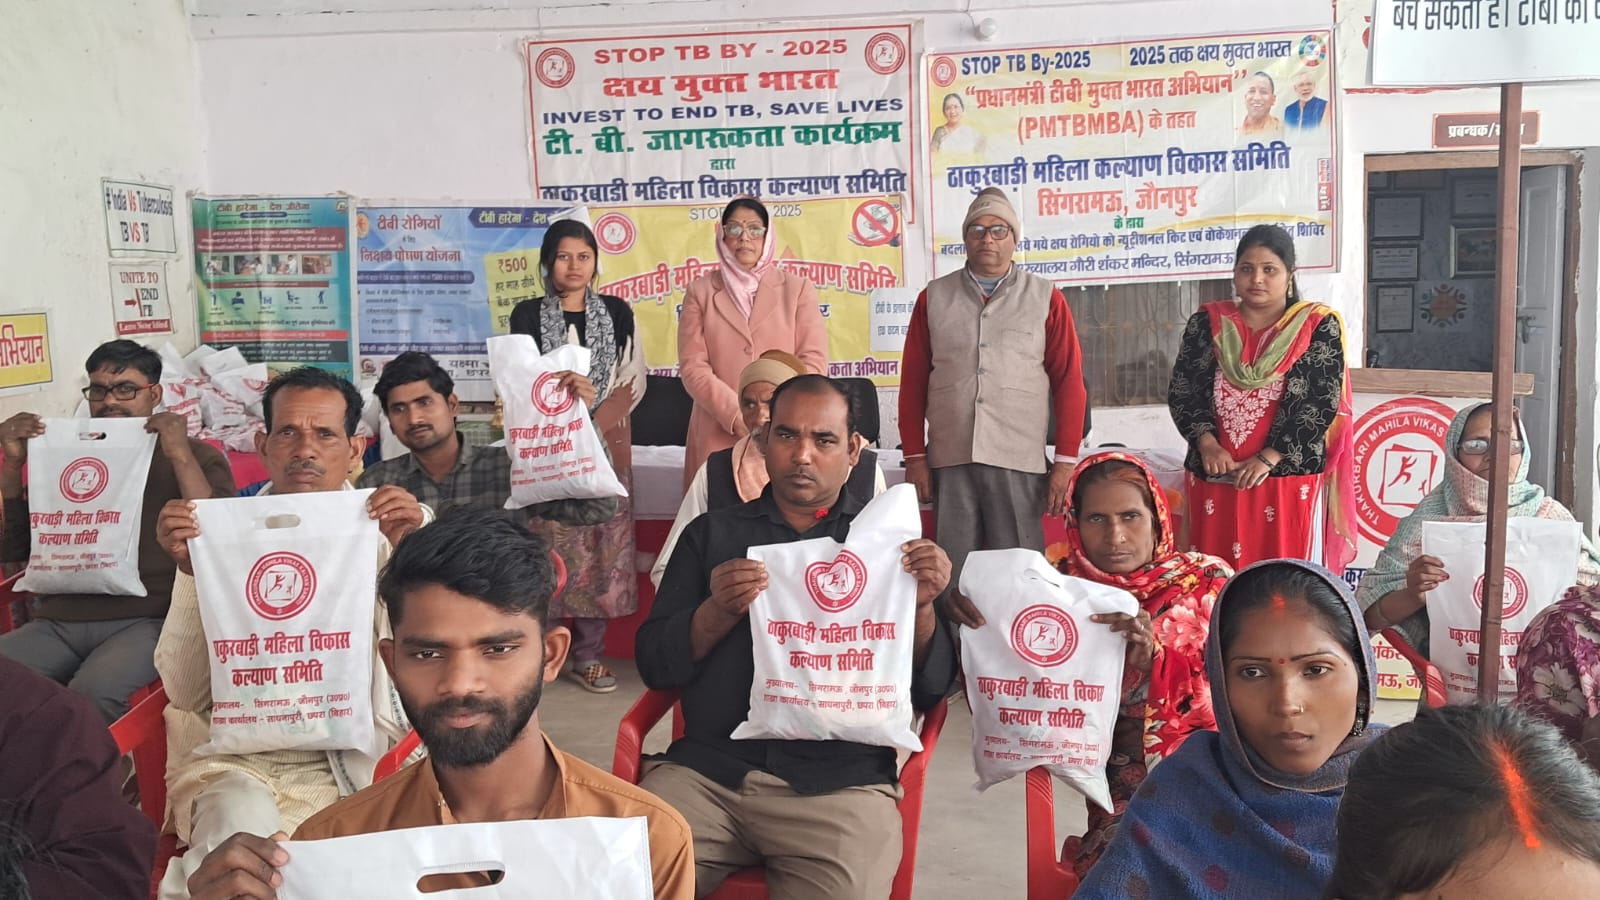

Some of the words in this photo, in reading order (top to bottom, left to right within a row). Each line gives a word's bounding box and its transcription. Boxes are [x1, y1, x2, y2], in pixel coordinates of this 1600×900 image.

[594, 47, 665, 64] STOP
[674, 45, 710, 60] TB
[720, 43, 757, 59] BY
[783, 39, 848, 56] 2025
[961, 55, 1001, 75] STOP
[1006, 54, 1026, 72] TB
[1031, 51, 1091, 75] By-2025
[1129, 46, 1165, 66] 2025
[1168, 46, 1193, 64] तक
[1197, 44, 1220, 61] क्षय
[1223, 42, 1255, 67] मुक्त
[1258, 40, 1292, 57] भारत
[603, 76, 666, 97] क्षय
[671, 73, 749, 102] मुक्त
[758, 69, 840, 91] भारत
[1050, 78, 1083, 104] टीबी
[1087, 80, 1124, 108] मुक्त
[1126, 79, 1165, 100] भारत
[543, 109, 625, 125] INVEST
[633, 108, 663, 120] TO
[672, 106, 717, 119] END
[725, 104, 762, 119] TB,
[770, 101, 829, 115] SAVE
[837, 98, 903, 114] LIVES
[542, 128, 583, 155] टी.
[592, 126, 634, 152] बी.
[642, 126, 786, 151] जागरूकता
[791, 117, 903, 145] कार्यक्रम
[1018, 110, 1144, 146] (PMTBMBA)
[1148, 108, 1162, 130] के
[1166, 110, 1197, 129] तहत
[1032, 154, 1090, 184] महिला
[1093, 155, 1162, 180] कल्याण
[1167, 147, 1228, 175] विकास
[1232, 140, 1291, 171] समिति
[632, 176, 695, 200] महिला
[698, 174, 762, 198] विकास
[766, 175, 840, 195] कल्याण
[844, 168, 907, 193] समिति
[773, 205, 802, 217] 2025
[1037, 187, 1129, 217] सिंगरामऊ,
[1135, 182, 1199, 216] जौनपुर
[377, 214, 398, 230] टीबी
[401, 214, 442, 230] रोगियों
[479, 212, 495, 224] टीबी
[1114, 215, 1124, 229] के
[120, 221, 129, 242] TB
[129, 221, 141, 242] VS
[141, 222, 149, 243] TB
[941, 243, 967, 255] बदला
[1033, 236, 1048, 250] गये
[1050, 237, 1067, 249] क्षय
[1103, 232, 1117, 247] को
[1167, 229, 1185, 244] किट
[1188, 227, 1203, 242] एवं
[394, 246, 423, 262] पोषण
[425, 246, 461, 262] योजना
[498, 257, 528, 274] ₹500
[1070, 256, 1095, 272] गौरी
[1098, 254, 1129, 271] शंकर
[119, 272, 146, 283] UNITE
[147, 272, 159, 283] TO
[140, 288, 159, 300] END
[827, 362, 853, 377] कता
[855, 357, 899, 376] अभियान
[1369, 415, 1410, 442] MAHILA
[1413, 415, 1446, 438] VIKAS
[66, 509, 94, 526] महिला
[39, 532, 72, 546] कल्याण
[264, 631, 304, 654] महिला
[309, 629, 351, 651] विकास
[819, 623, 858, 643] महिला
[862, 619, 896, 640] विकास
[789, 651, 832, 671] कल्याण
[837, 648, 874, 671] समिति
[232, 667, 277, 686] कल्याण
[282, 659, 323, 684] समिति
[977, 676, 1029, 701] ठाकुरबाड़ी
[1032, 677, 1070, 700] महिला
[998, 707, 1043, 726] कल्याण
[1047, 706, 1086, 728] समिति
